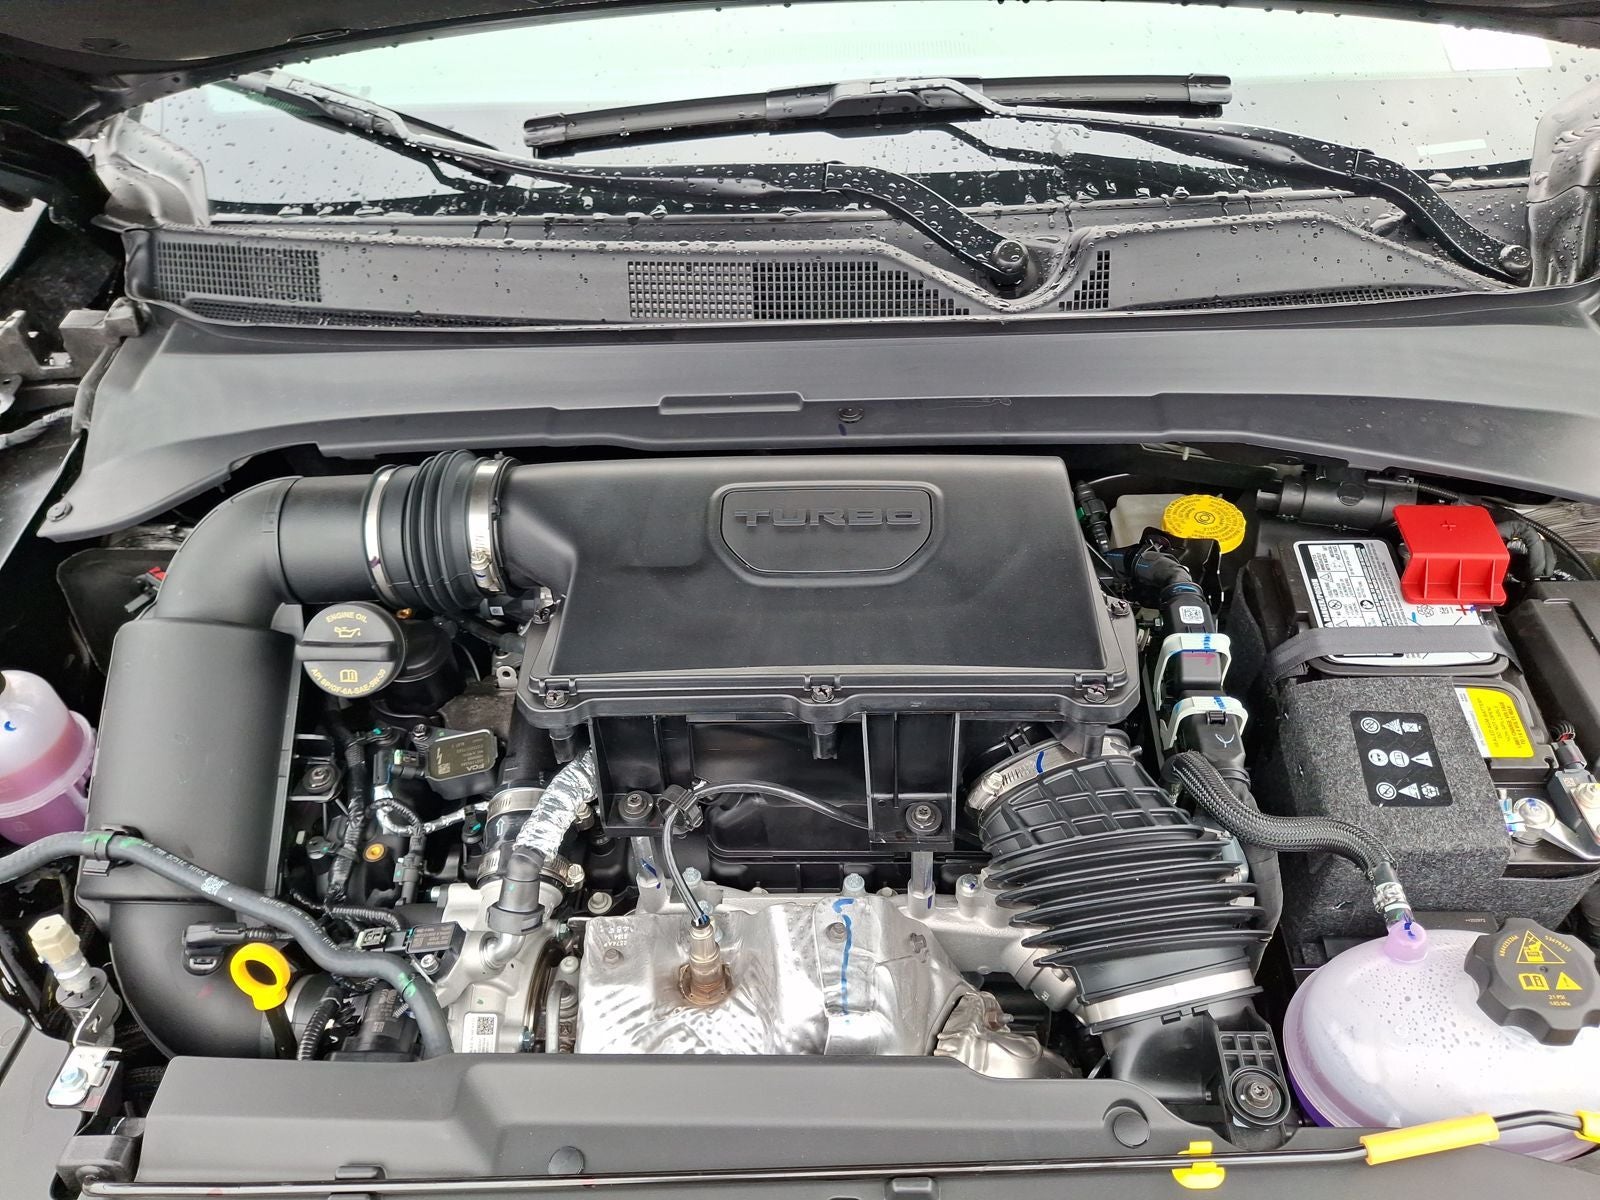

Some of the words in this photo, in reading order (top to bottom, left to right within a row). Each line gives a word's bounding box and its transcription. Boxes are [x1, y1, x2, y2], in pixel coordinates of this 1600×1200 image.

[734, 508, 921, 527] TURBO
[326, 611, 355, 623] ENGINE
[355, 614, 368, 624] OIL
